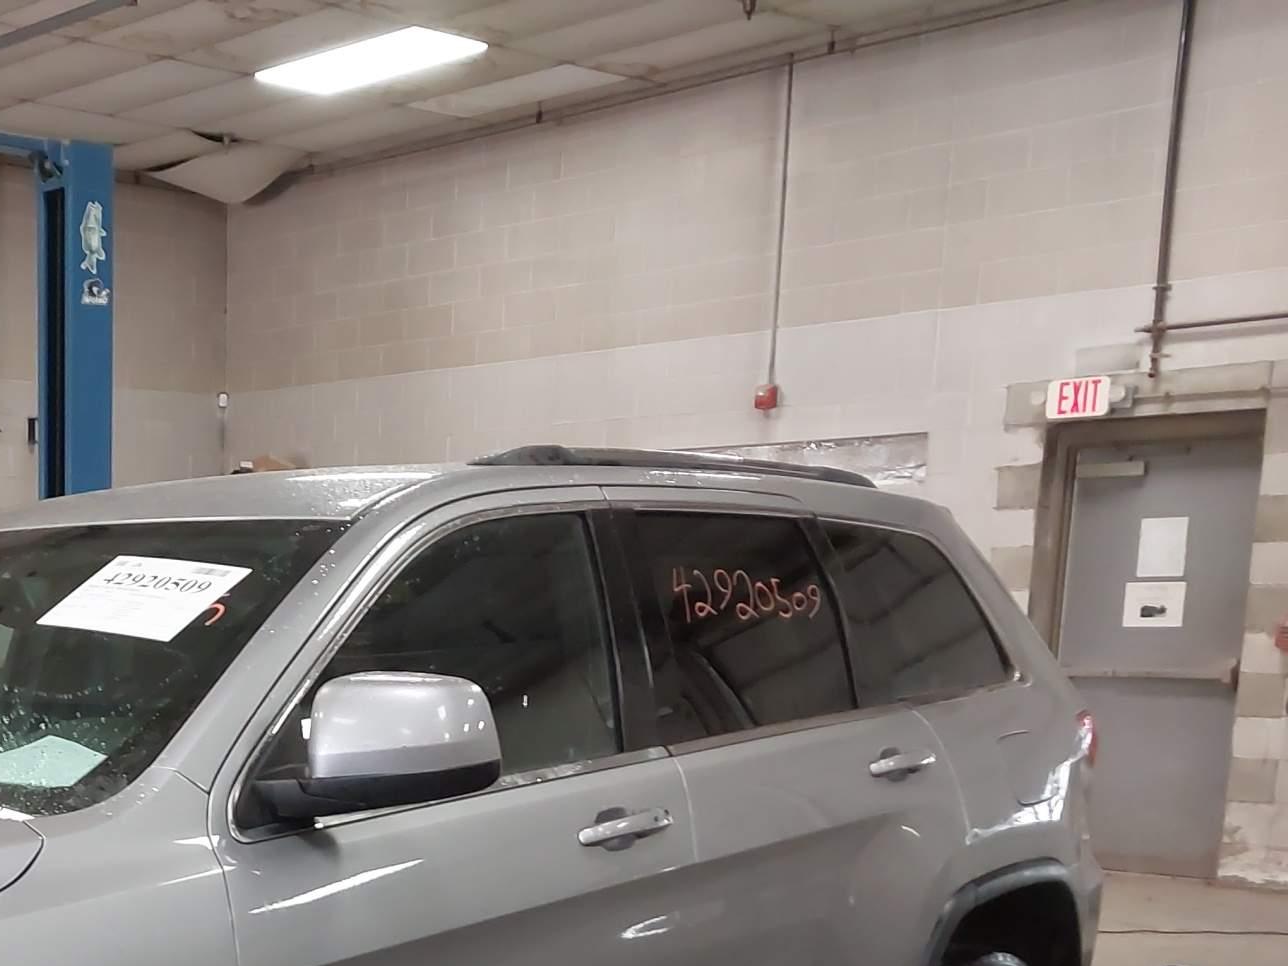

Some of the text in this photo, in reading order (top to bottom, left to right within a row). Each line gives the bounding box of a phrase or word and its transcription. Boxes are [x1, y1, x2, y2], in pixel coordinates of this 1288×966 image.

[1056, 379, 1102, 415] EXIT
[104, 571, 213, 593] 42920509
[672, 565, 821, 624] 42920509
